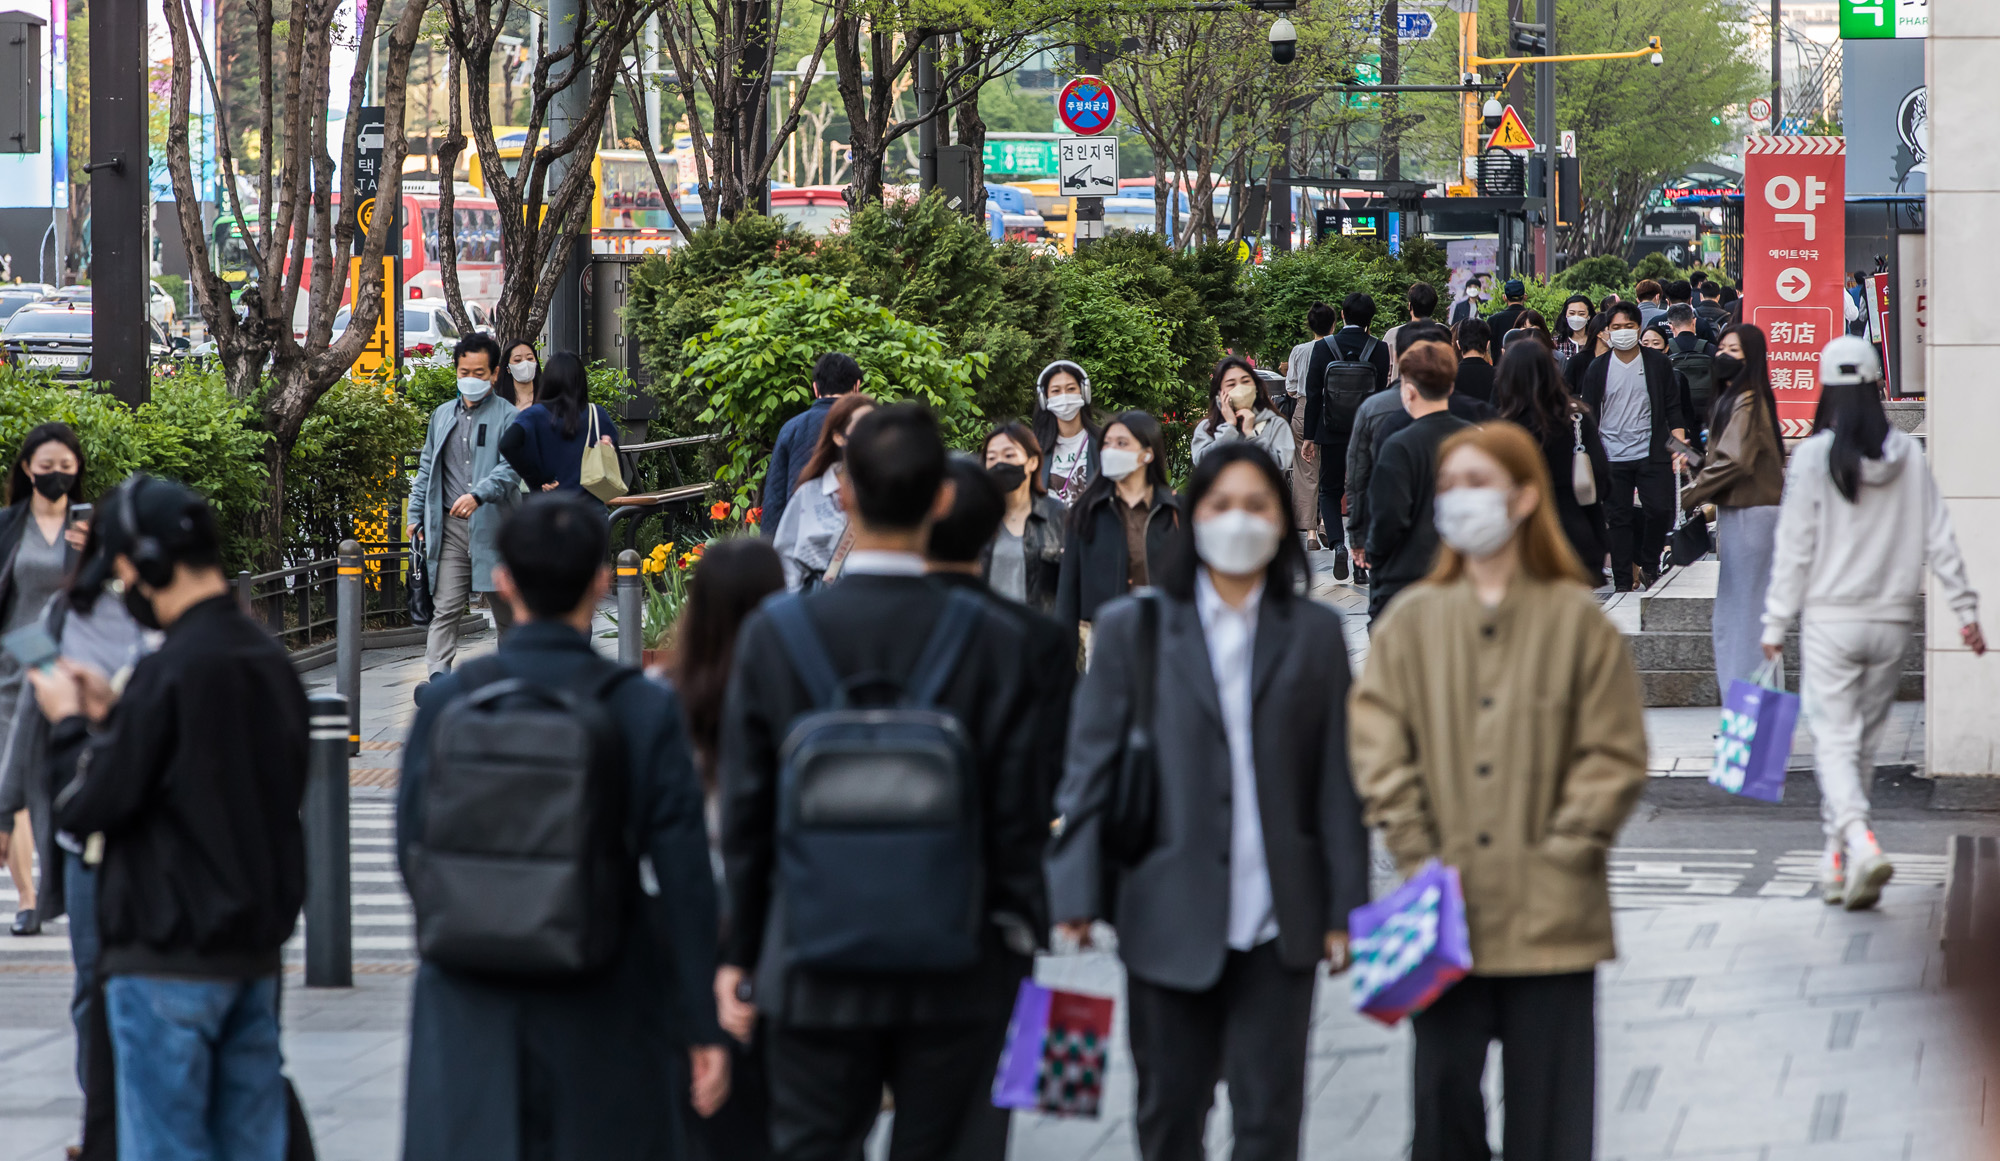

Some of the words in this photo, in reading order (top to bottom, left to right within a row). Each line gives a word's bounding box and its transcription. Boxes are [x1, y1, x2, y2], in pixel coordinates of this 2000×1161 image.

[1067, 101, 1109, 111] 주정차금지
[1062, 143, 1115, 161] 견인지역
[1764, 175, 1826, 241] 약
[1768, 249, 1820, 261] 에이트약국
[1770, 321, 1816, 344] 药店
[1766, 351, 1825, 362] HARMACY
